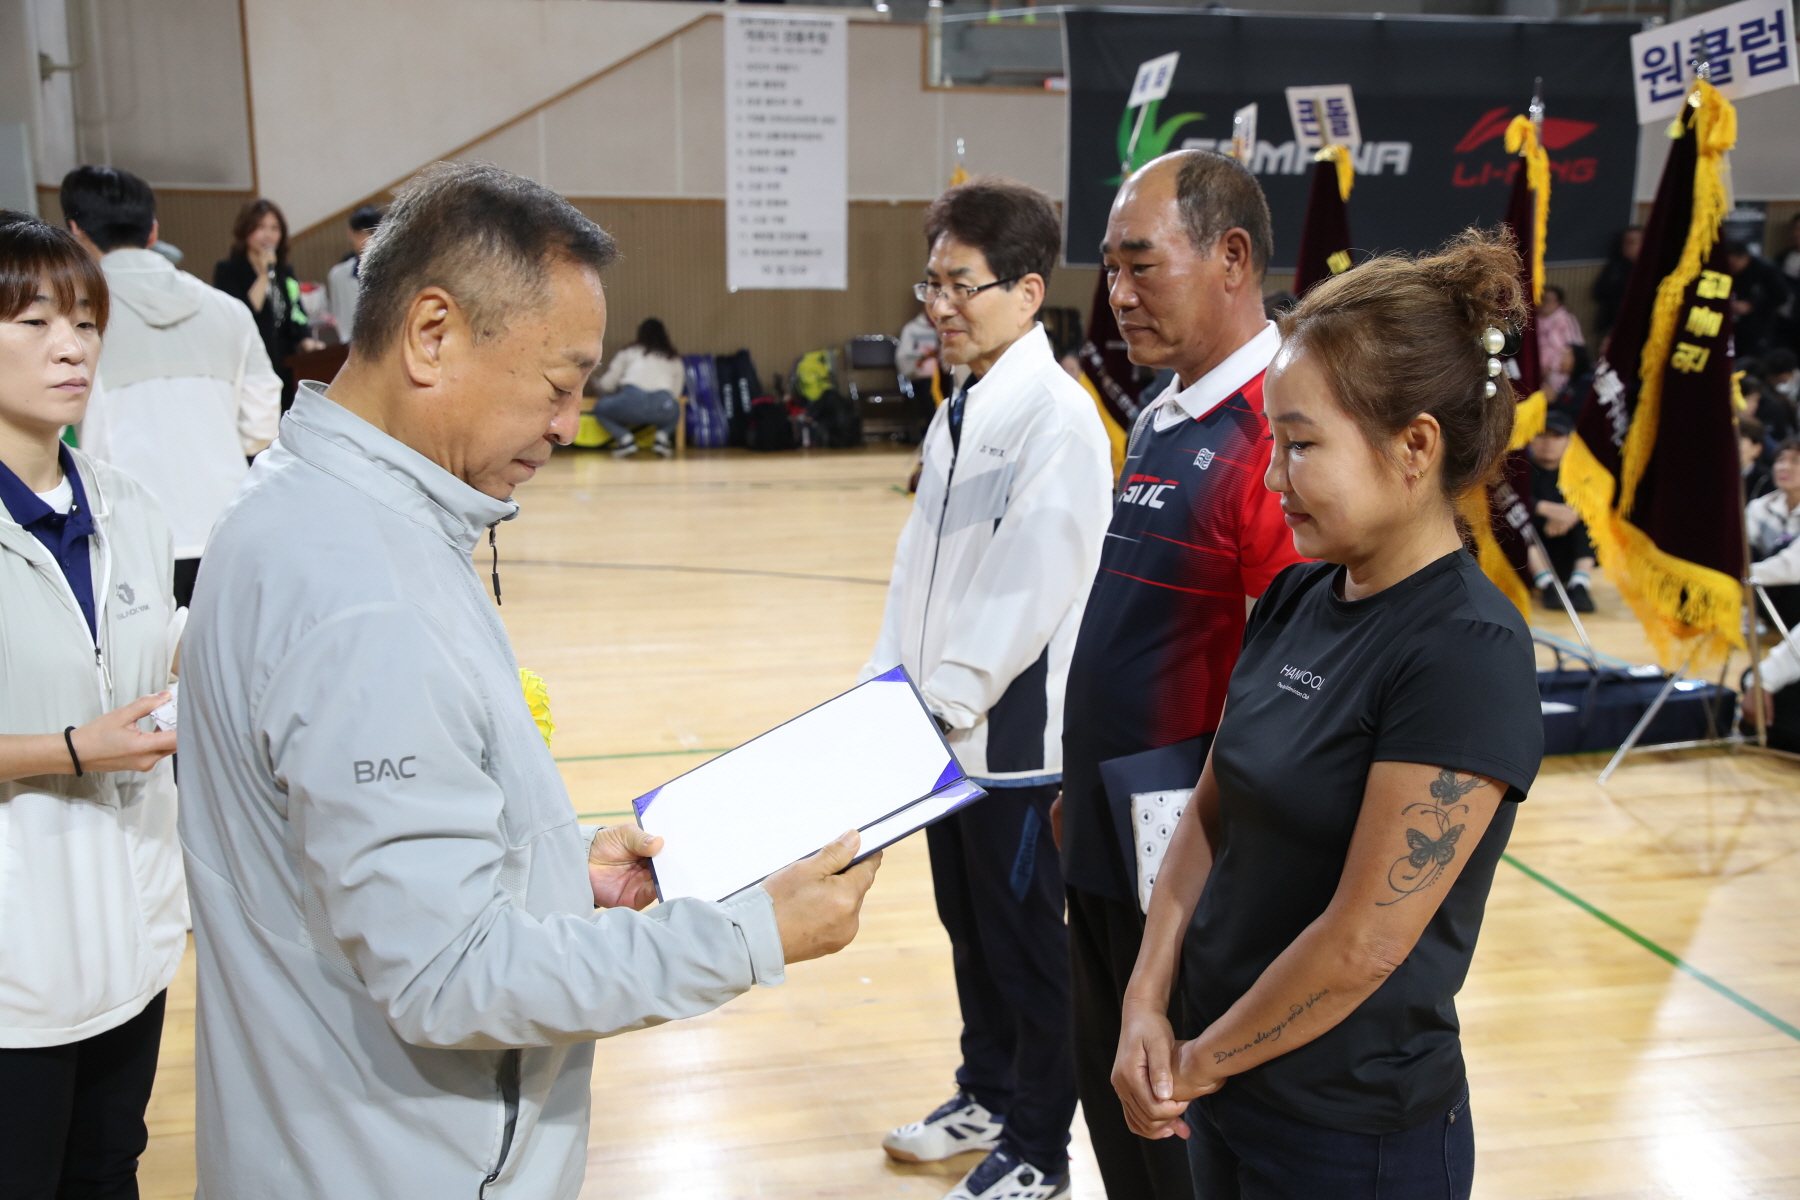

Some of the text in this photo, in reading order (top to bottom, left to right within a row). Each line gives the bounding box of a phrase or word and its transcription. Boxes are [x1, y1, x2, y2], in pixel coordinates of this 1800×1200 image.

[1641, 9, 1788, 104] 원클럽
[1453, 157, 1598, 188] LI-NG
[353, 755, 417, 784] BAC
[1253, 1020, 1288, 1042] always
[1288, 1004, 1304, 1022] and
